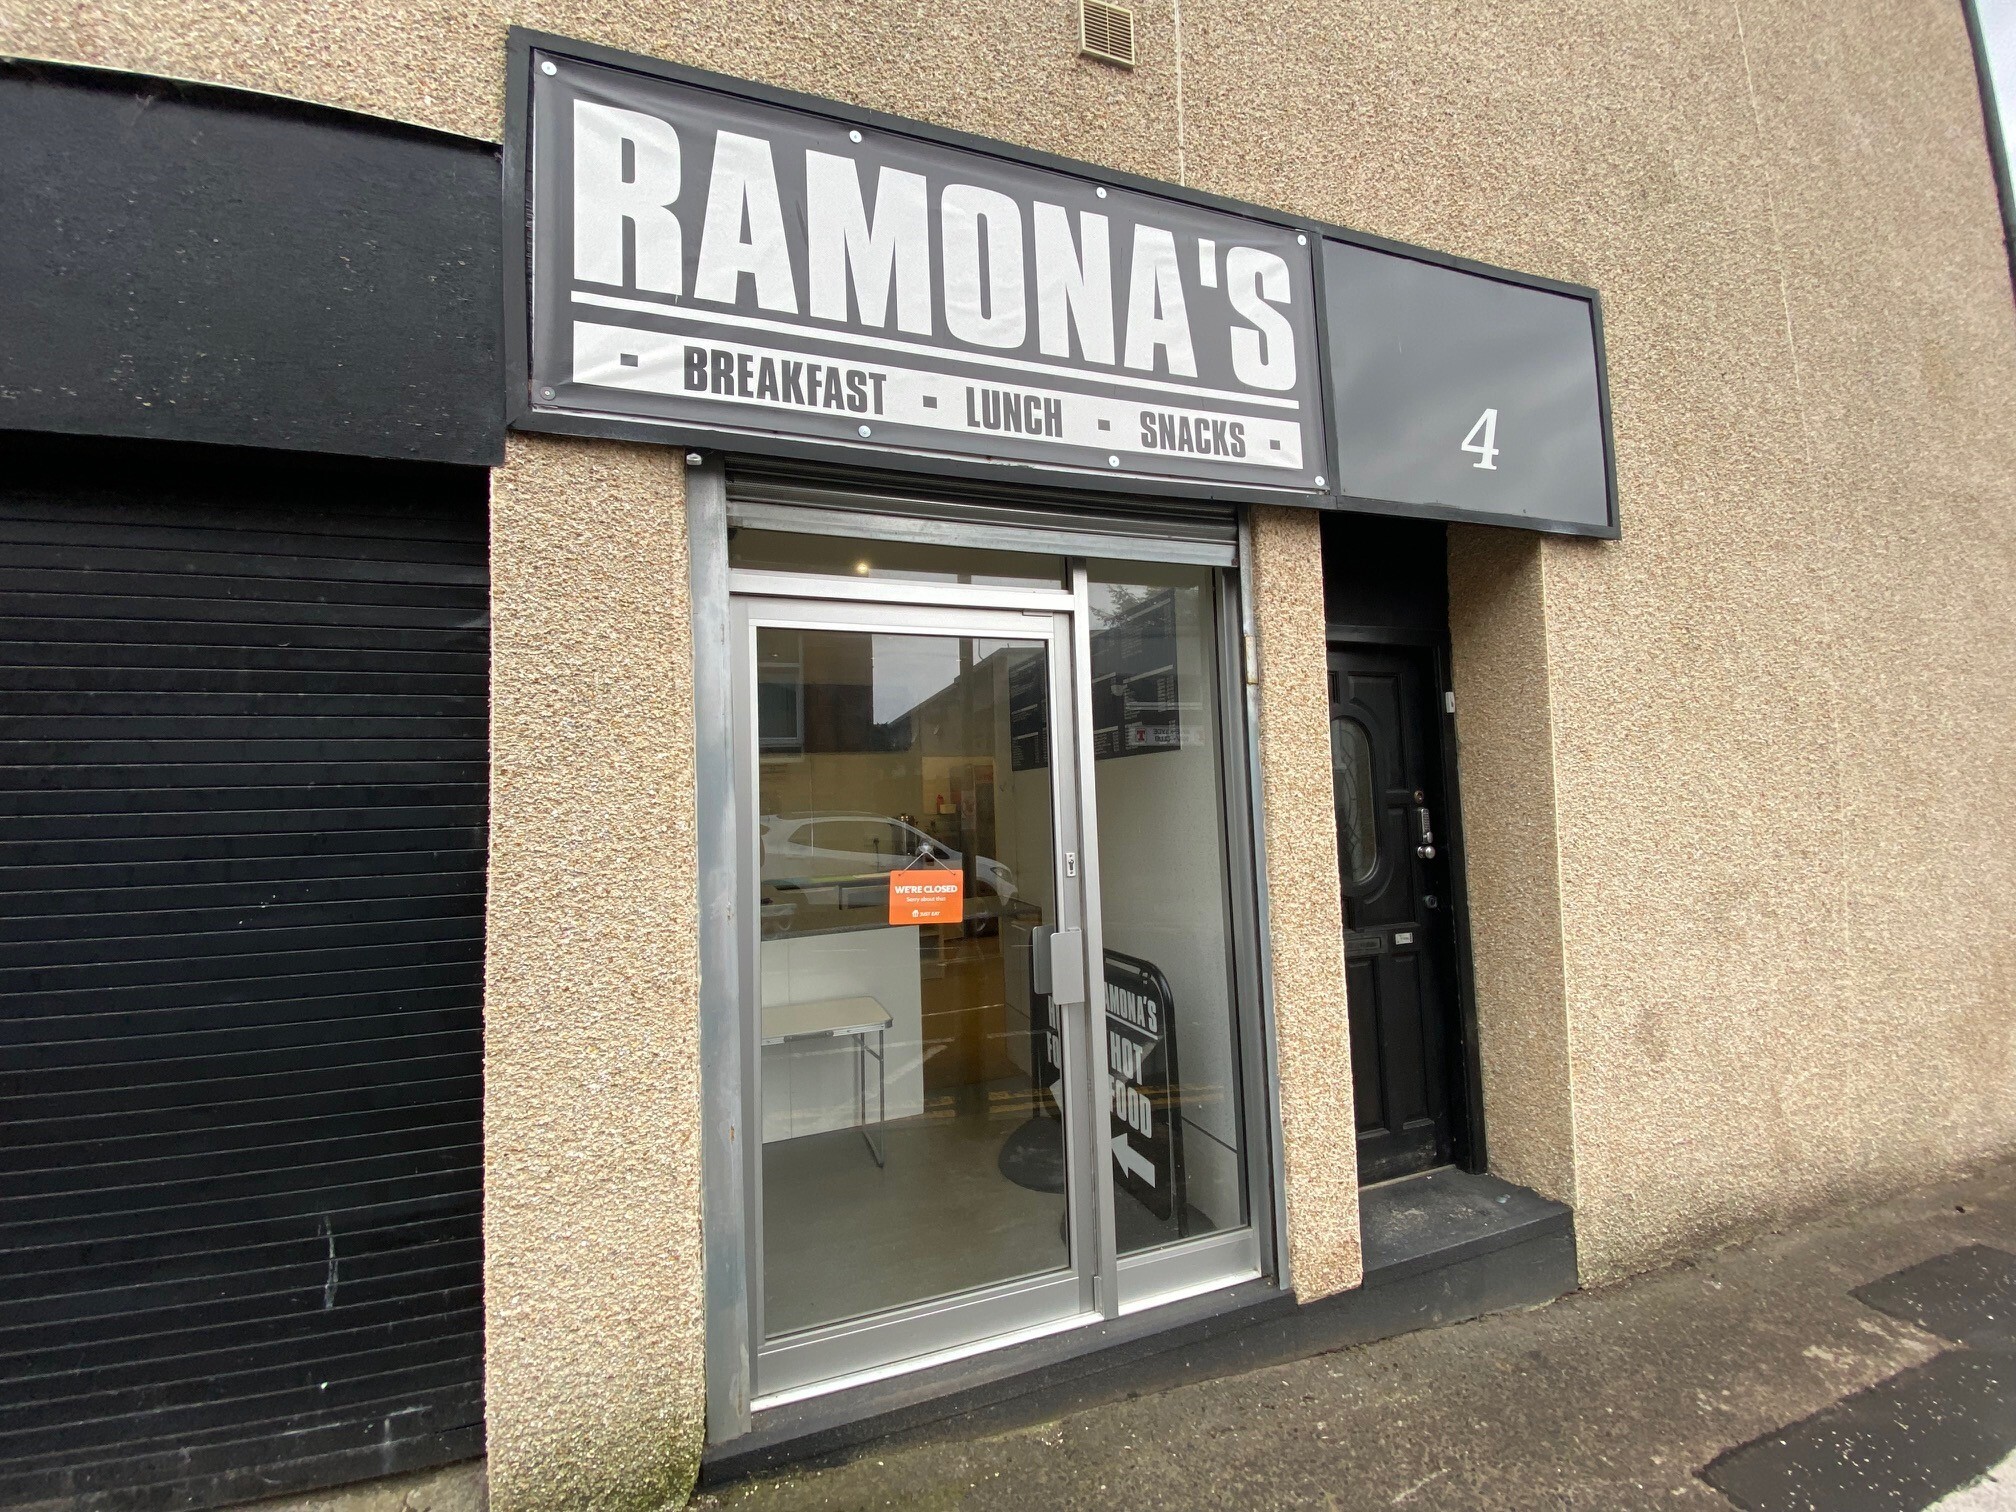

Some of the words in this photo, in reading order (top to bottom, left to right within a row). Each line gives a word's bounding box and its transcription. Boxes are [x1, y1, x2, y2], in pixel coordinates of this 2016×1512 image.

[573, 99, 1298, 391] RAMONA'S
[683, 345, 887, 416] BREAKFAST
[965, 386, 1063, 438] LUNCH
[1140, 411, 1247, 458] SNACKS
[1460, 408, 1500, 470] 4
[894, 886, 923, 894] WE'RE
[923, 885, 958, 893] CLOSED
[1104, 982, 1158, 1033] AMONA'S
[1109, 1030, 1143, 1086] HOT
[1108, 1074, 1152, 1139] FOOD
